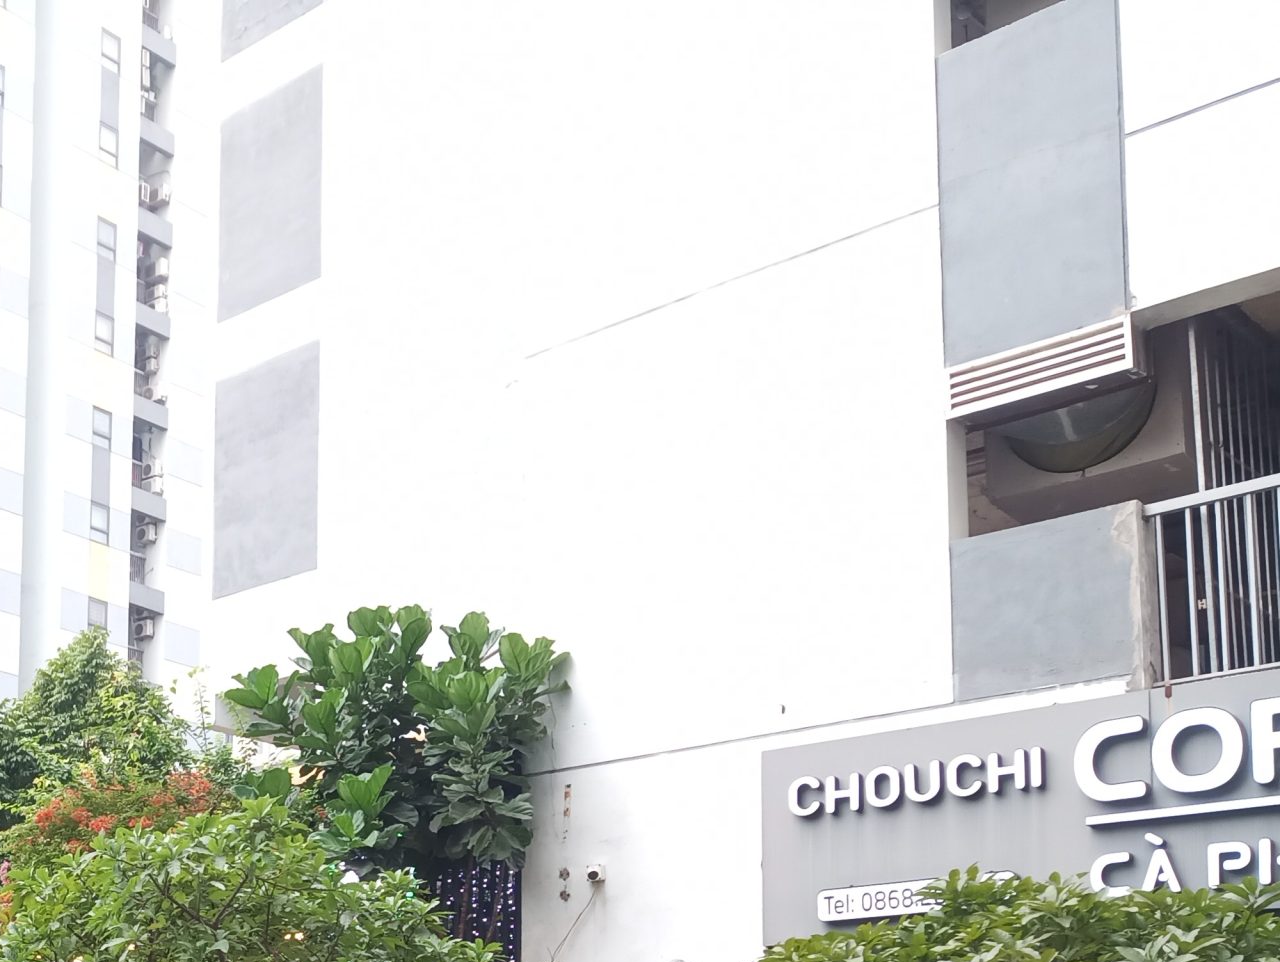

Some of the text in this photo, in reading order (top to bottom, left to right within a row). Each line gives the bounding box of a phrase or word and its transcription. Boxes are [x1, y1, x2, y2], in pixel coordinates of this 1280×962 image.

[788, 746, 1043, 817] CHOUCHI
[1090, 832, 1182, 897] CÀ
[824, 895, 855, 915] Tel:
